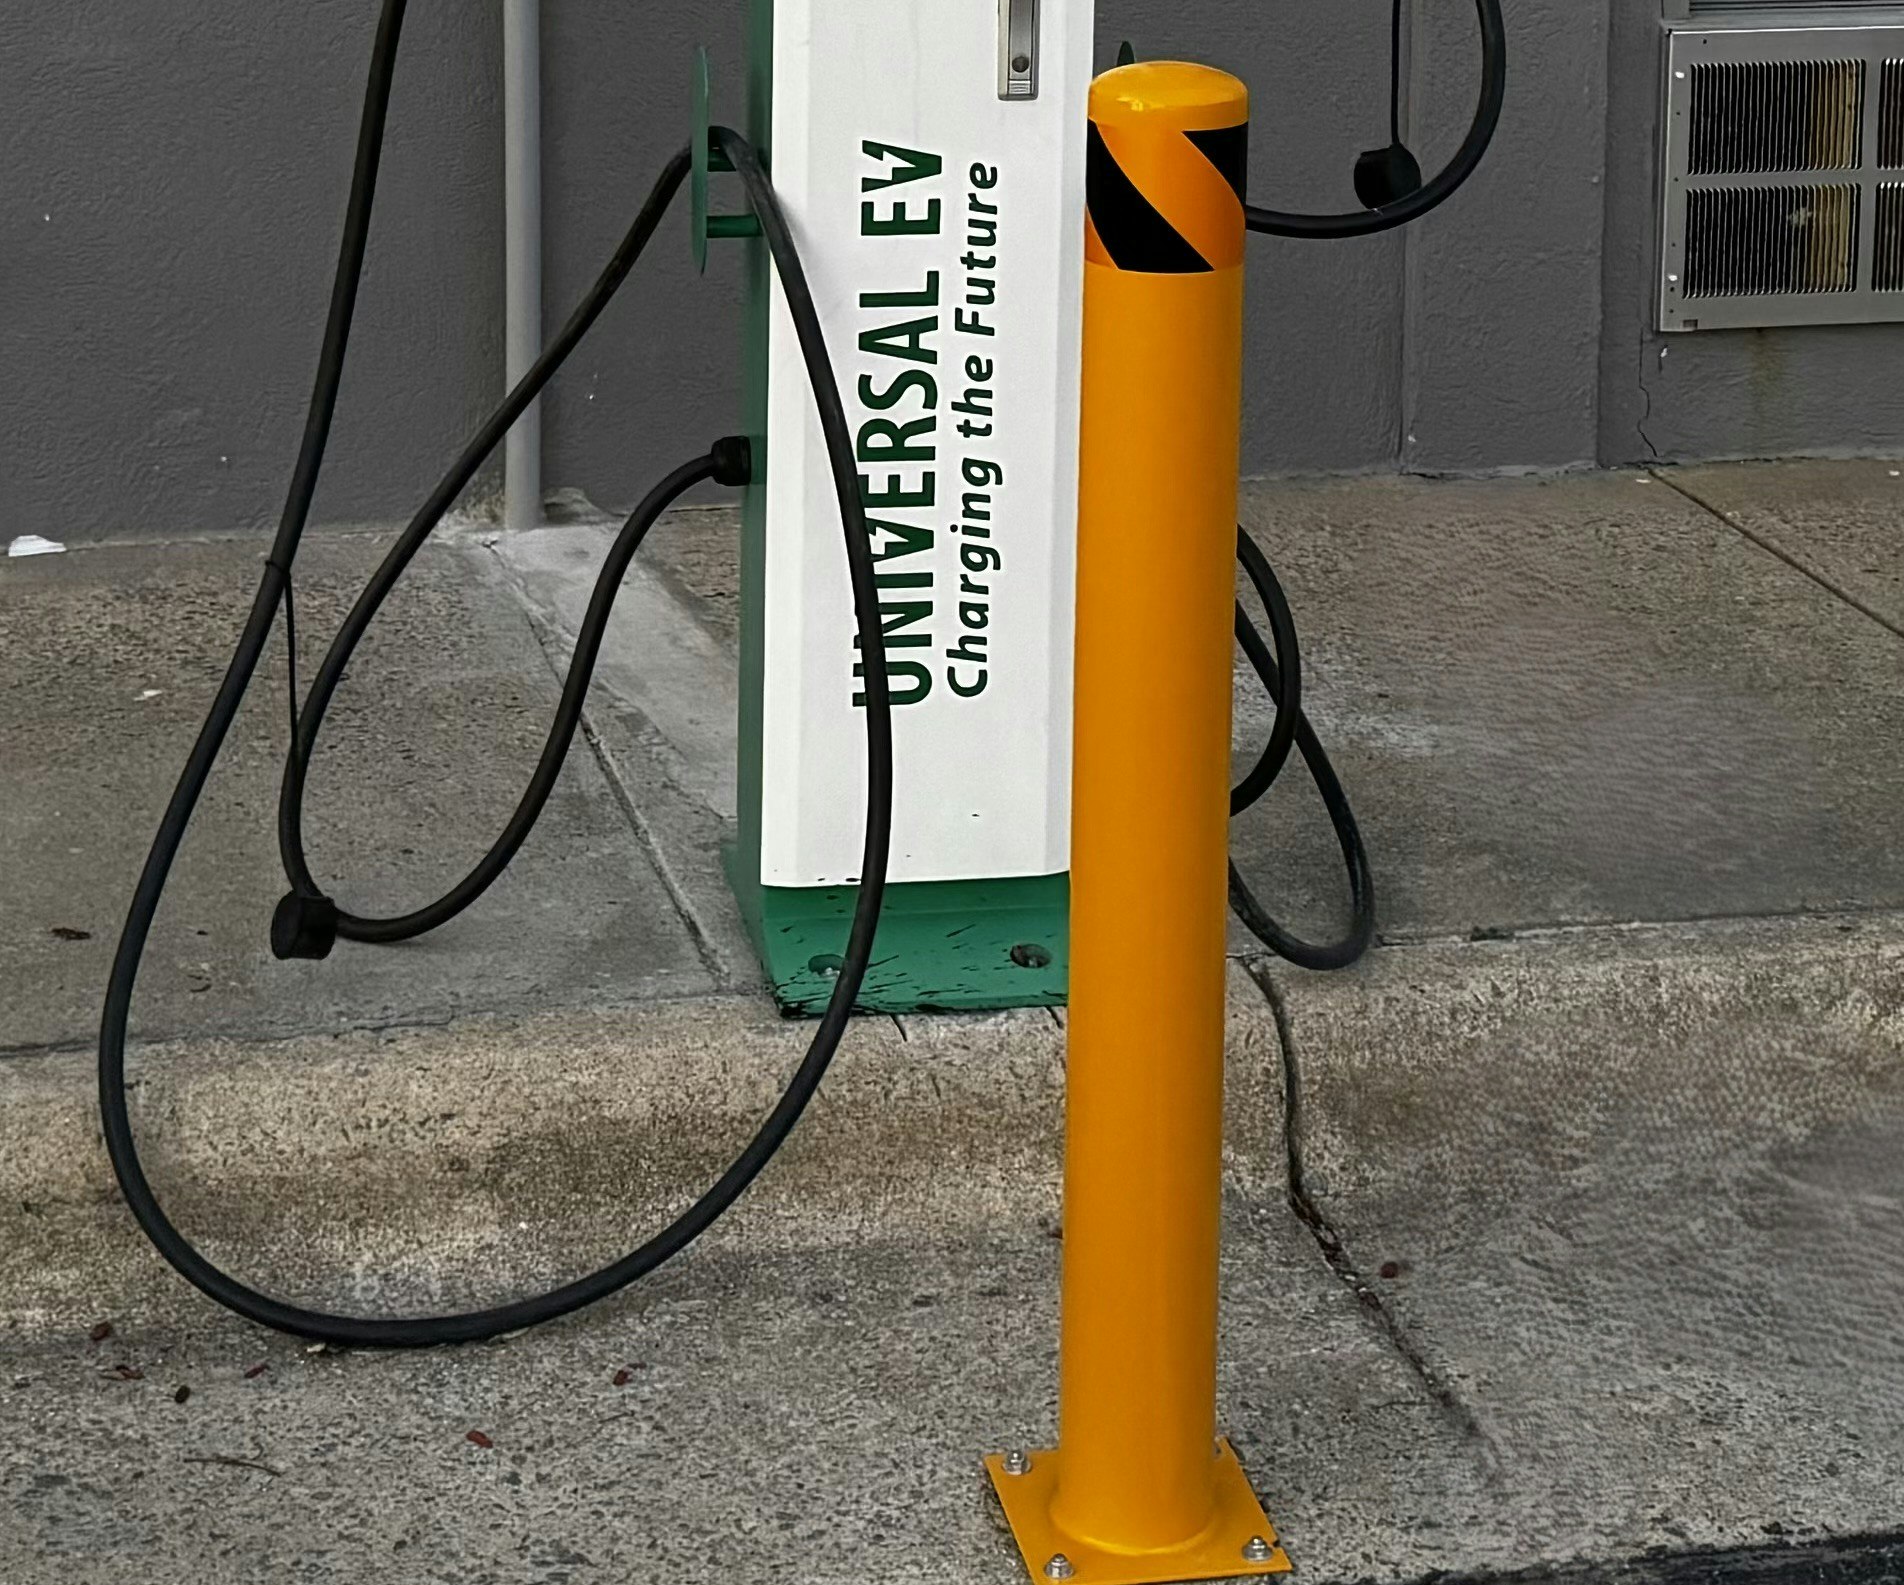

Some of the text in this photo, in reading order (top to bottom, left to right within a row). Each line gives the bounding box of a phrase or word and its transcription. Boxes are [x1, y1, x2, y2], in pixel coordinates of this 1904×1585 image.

[852, 139, 942, 708] UNIVERSAL EV
[946, 161, 1003, 698] Charging the Future
